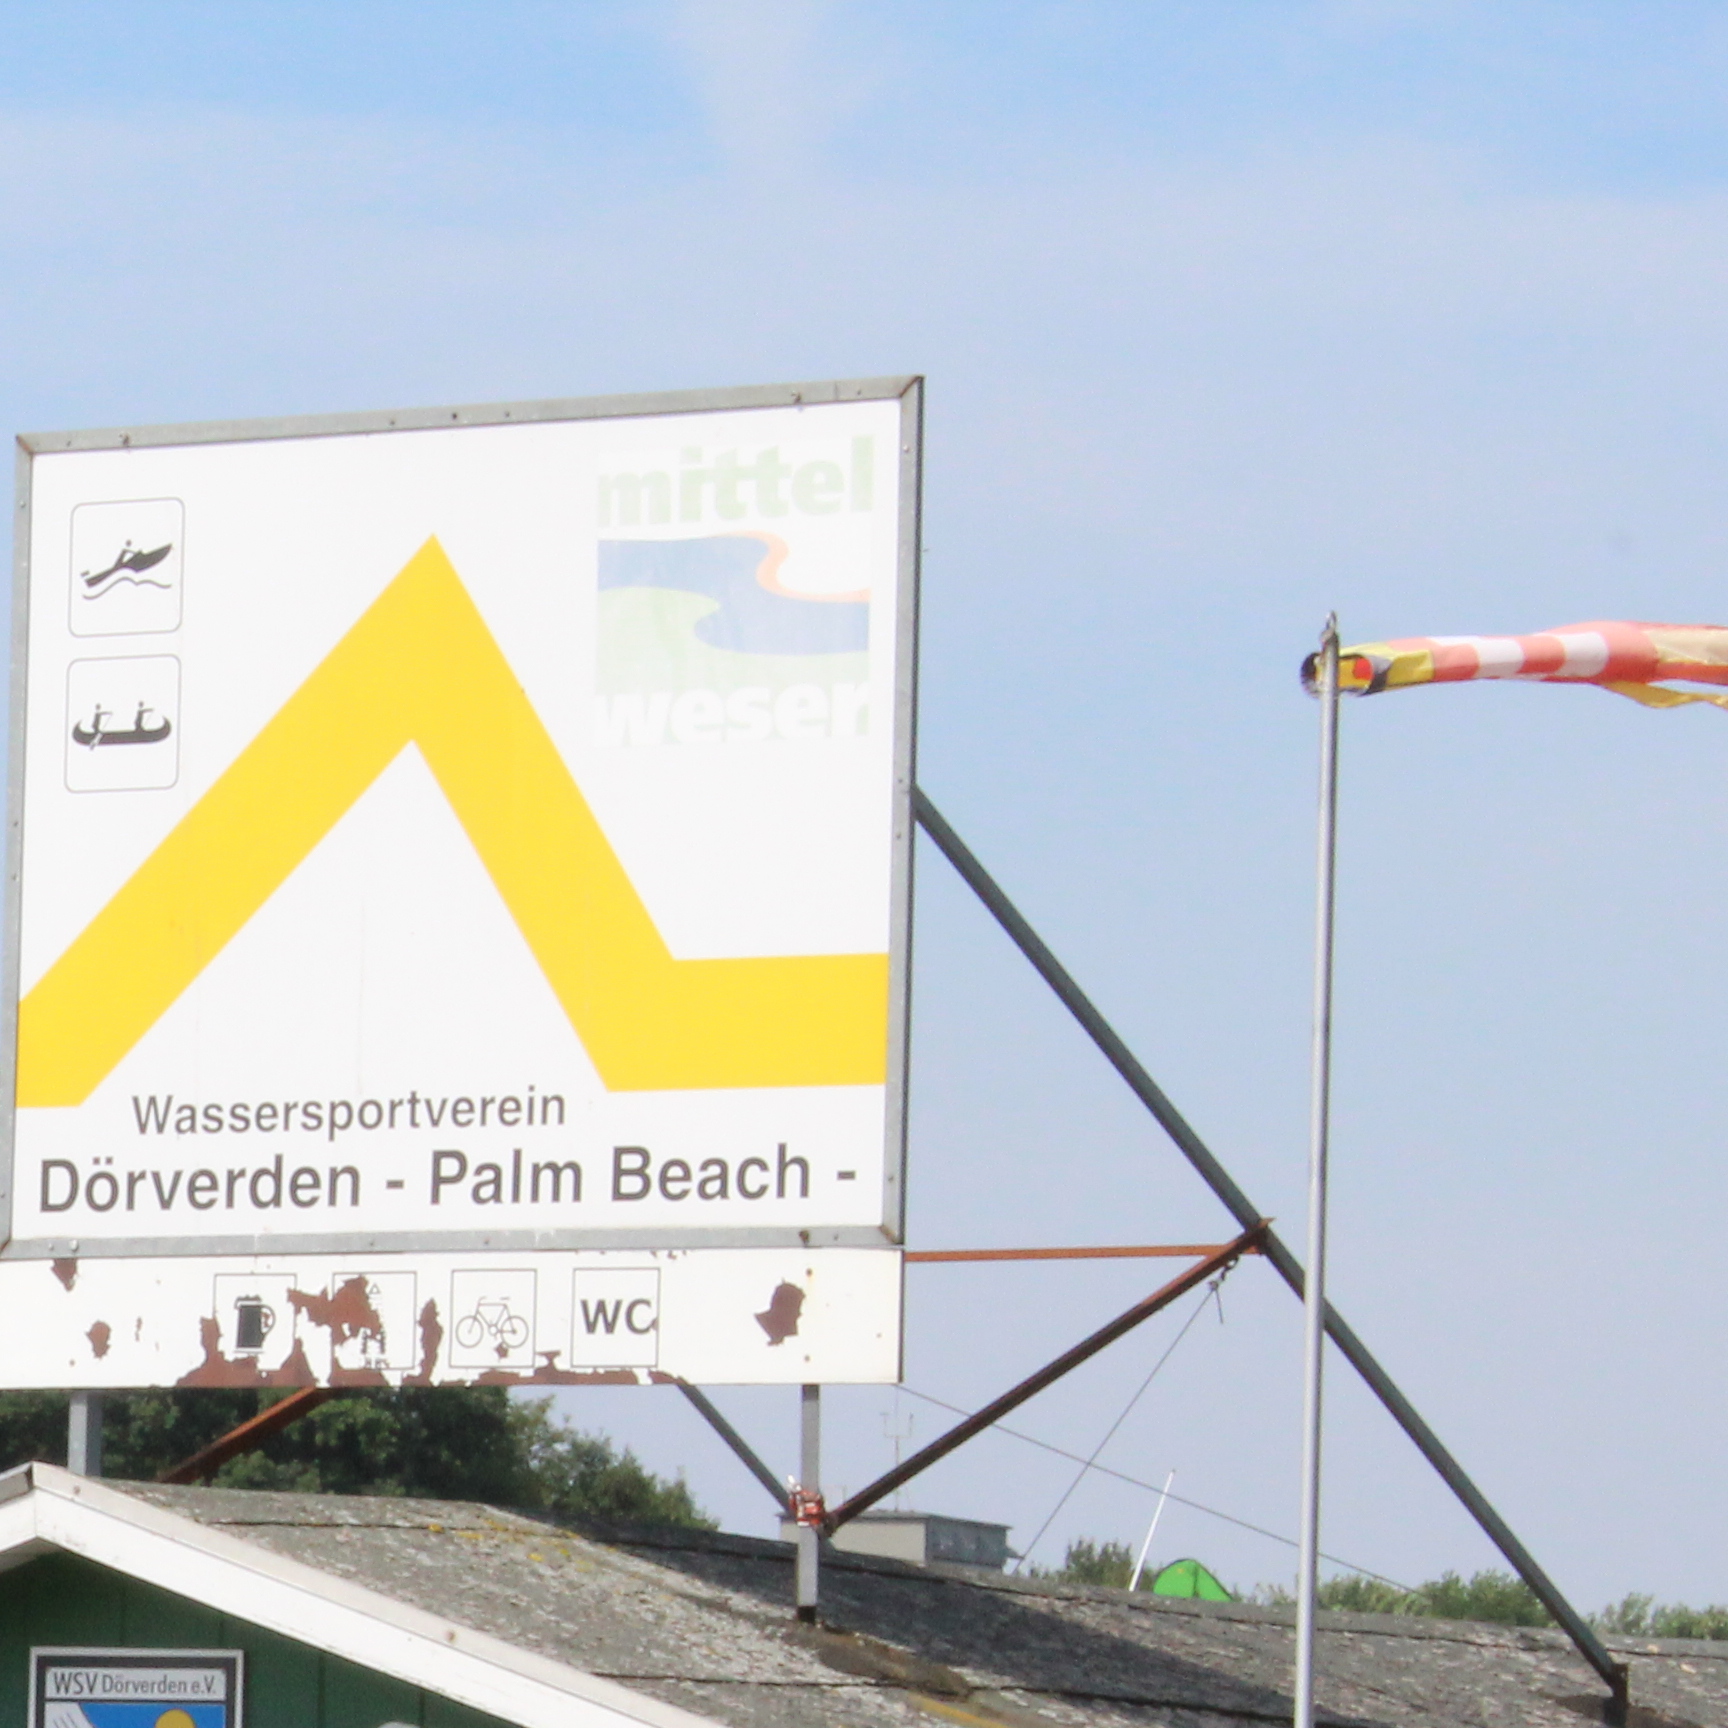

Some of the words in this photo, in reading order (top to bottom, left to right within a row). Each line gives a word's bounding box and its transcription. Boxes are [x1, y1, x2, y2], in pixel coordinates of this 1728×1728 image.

[597, 434, 876, 528] mittel
[594, 681, 870, 748] weser
[131, 1084, 566, 1142] Wassersportverein
[39, 1153, 361, 1214] Dörverden
[429, 1148, 583, 1206] Palm
[610, 1142, 810, 1203] Beach
[580, 1298, 653, 1335] WC
[53, 1671, 98, 1696] WSV
[102, 1674, 187, 1694] Dörverden
